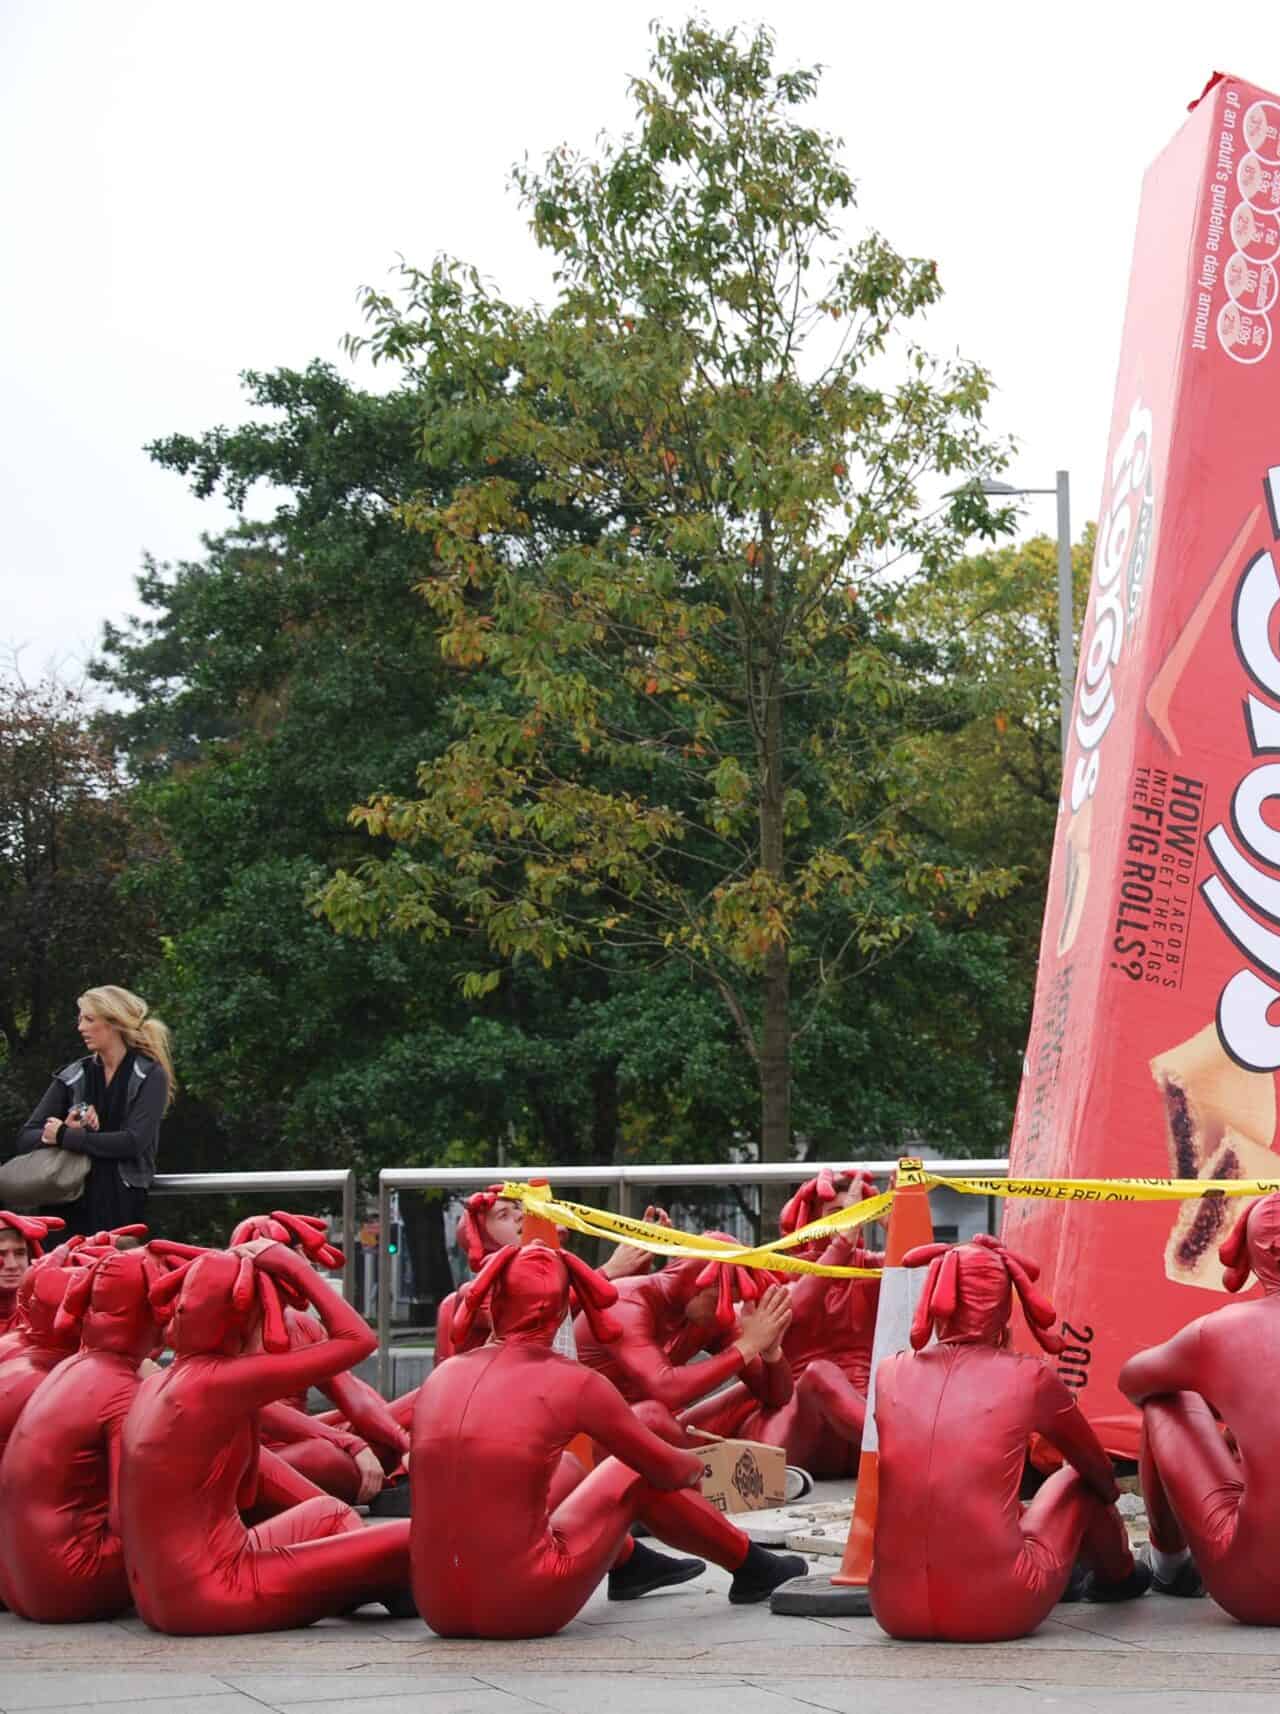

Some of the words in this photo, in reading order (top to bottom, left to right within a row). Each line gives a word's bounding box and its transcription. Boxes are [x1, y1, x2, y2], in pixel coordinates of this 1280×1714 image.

[1223, 109, 1236, 128] an
[1226, 91, 1241, 108] of
[1215, 131, 1235, 181] adult's
[1206, 184, 1227, 251] guideline
[1198, 255, 1219, 289] daily
[1191, 293, 1212, 350] amount
[1133, 767, 1151, 803] THE
[1150, 769, 1169, 808] INTO
[1127, 804, 1164, 856] FIG
[1164, 774, 1204, 858] HOW
[1157, 853, 1175, 889] GET
[1176, 858, 1193, 885] DO
[1110, 859, 1157, 981] ROLLS?
[1152, 897, 1170, 930] THE
[1145, 939, 1164, 984] FIGS
[1162, 896, 1188, 989] JACOB'S
[1057, 1321, 1095, 1400] 200
